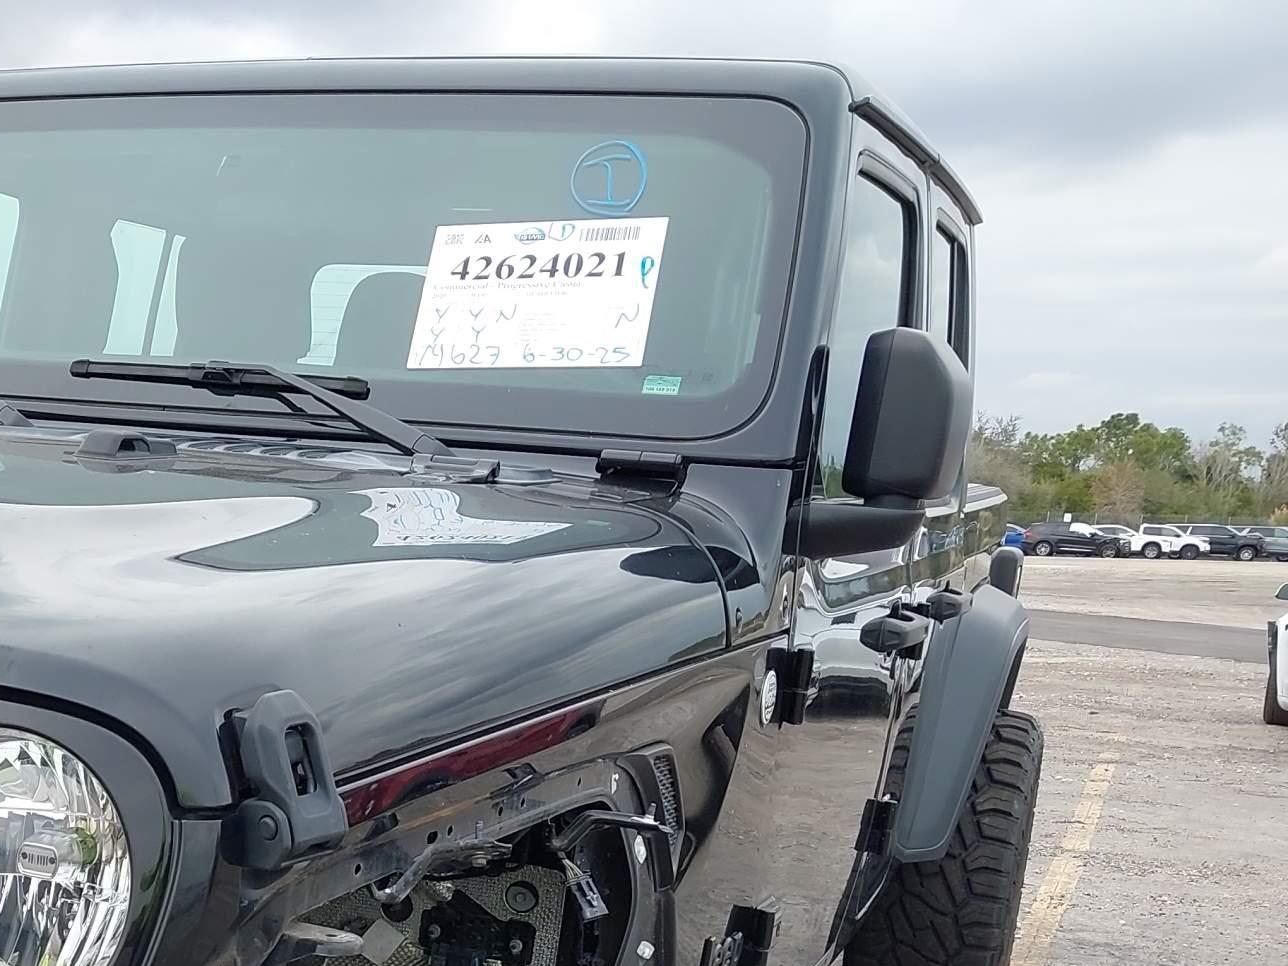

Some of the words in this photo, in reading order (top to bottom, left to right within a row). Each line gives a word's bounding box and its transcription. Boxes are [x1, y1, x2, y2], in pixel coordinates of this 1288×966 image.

[450, 251, 626, 280] 42624021
[495, 304, 517, 323] N
[615, 304, 640, 328] N
[522, 343, 631, 364] 6-30-25
